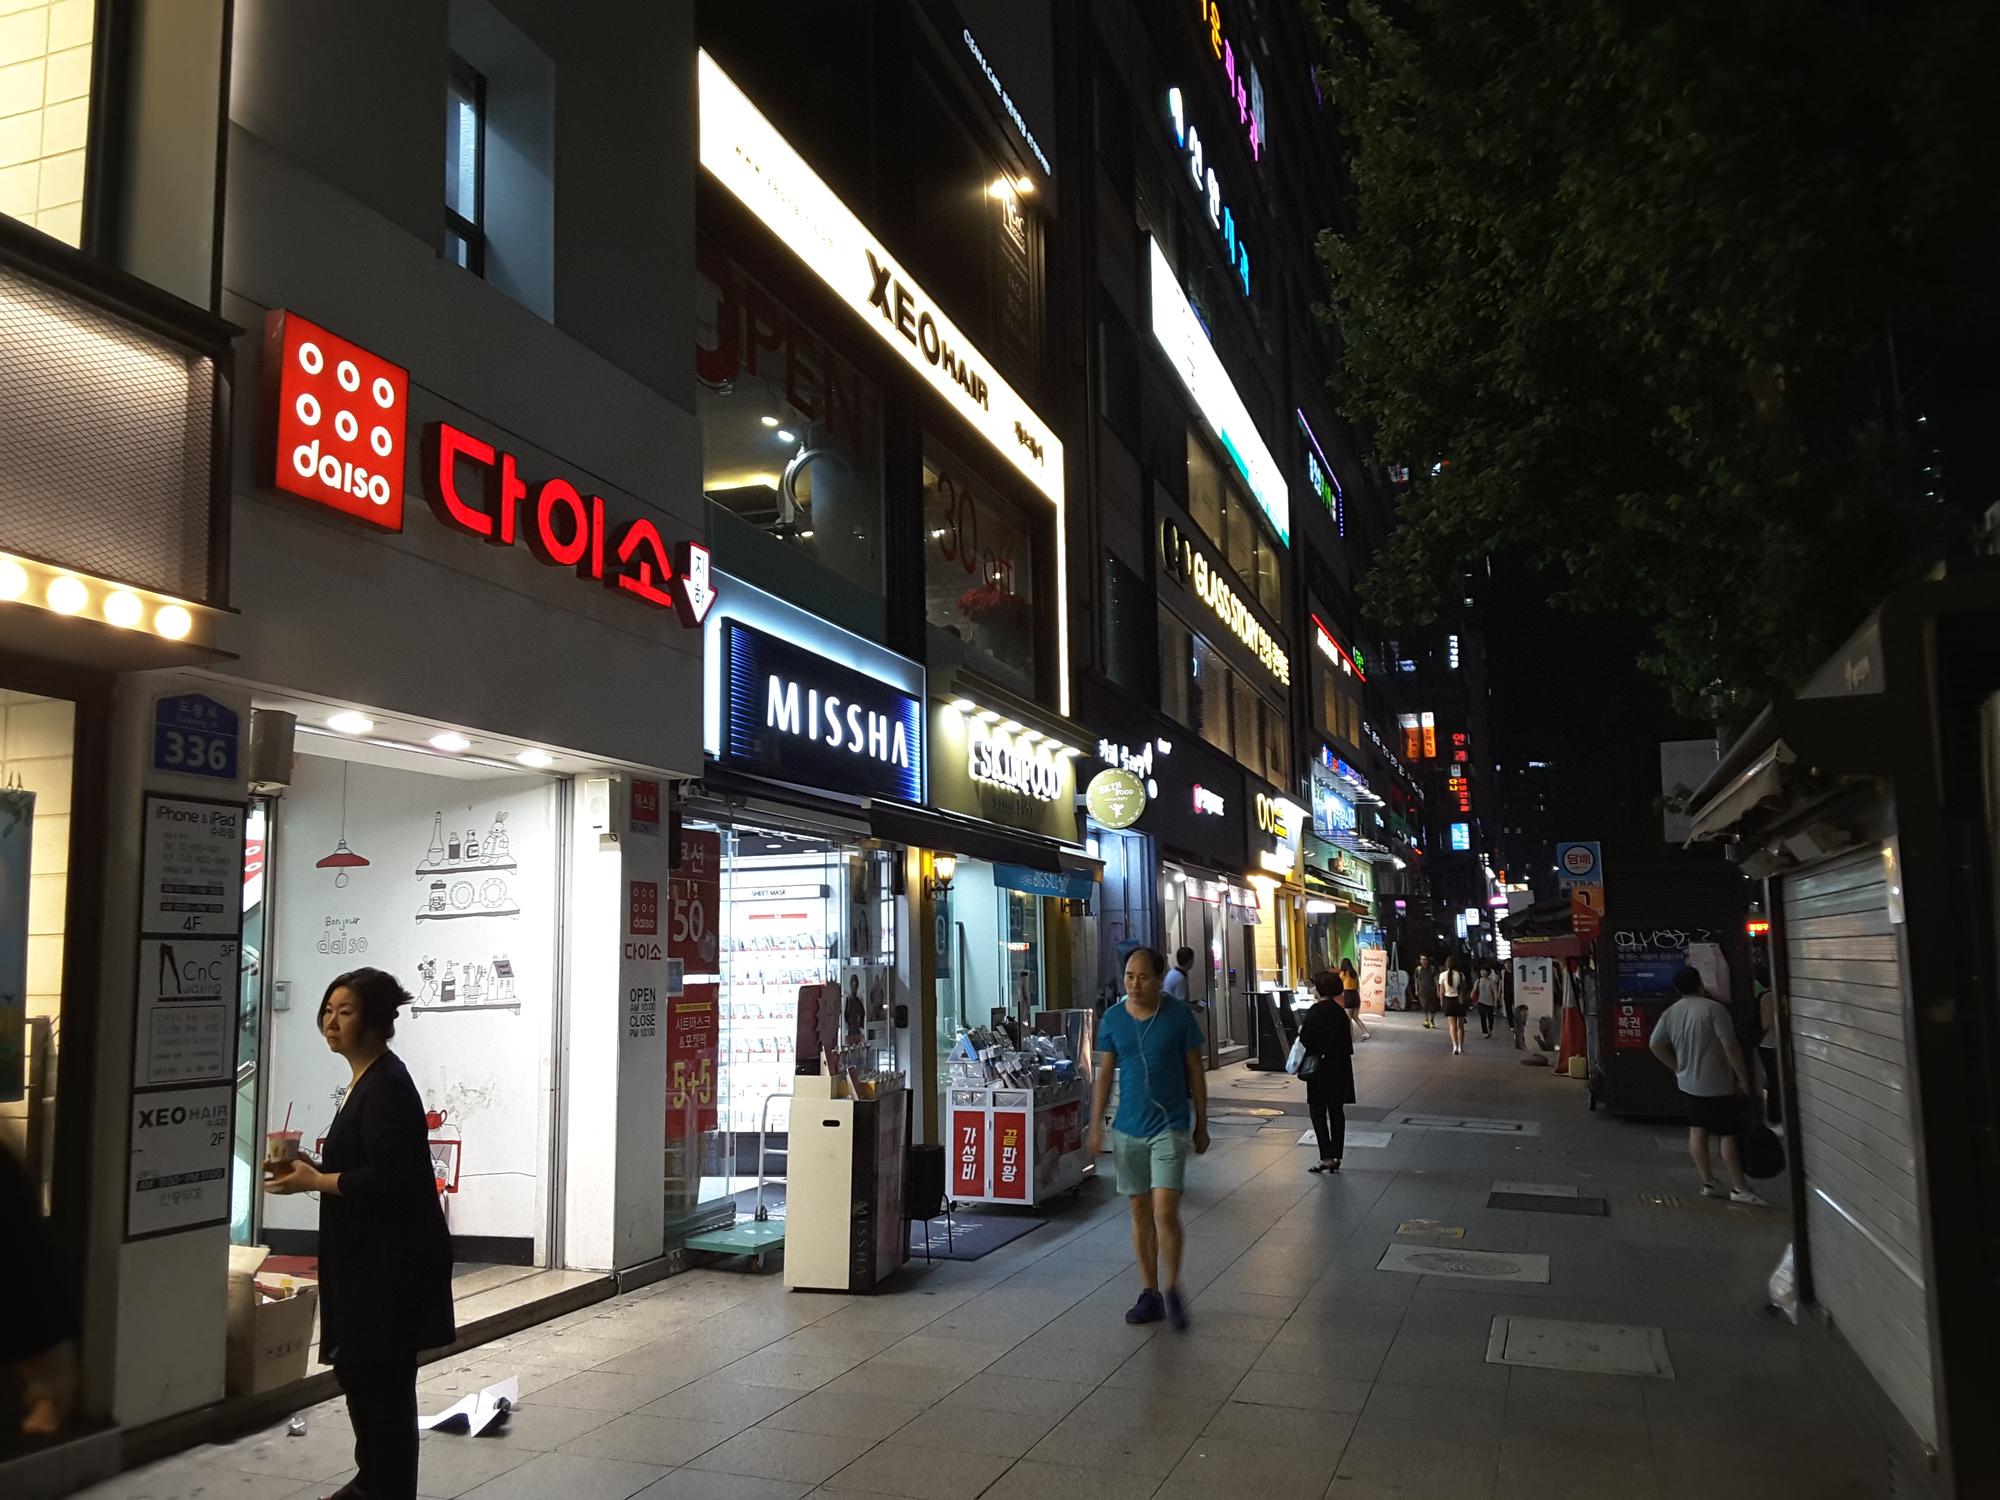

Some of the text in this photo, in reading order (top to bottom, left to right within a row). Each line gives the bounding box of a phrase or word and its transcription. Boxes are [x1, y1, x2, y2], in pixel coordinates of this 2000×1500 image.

[864, 247, 989, 413] XEO HAIR
[292, 439, 390, 506] daiso
[437, 421, 673, 609] 다이소
[1194, 551, 1231, 625] GLASS
[1230, 592, 1259, 655] STORY
[767, 674, 909, 769] MISSHA
[165, 731, 227, 770] 336
[974, 739, 1063, 801] SKINFOOD
[156, 806, 199, 823] iPhone
[209, 811, 236, 827] iPad
[1567, 854, 1591, 865] 담배
[182, 915, 203, 931] 4F
[325, 916, 361, 931] Bonjour
[633, 915, 655, 929] daiso
[672, 899, 705, 943] 50
[220, 944, 235, 958] 3F
[317, 931, 368, 955] daiso
[625, 943, 662, 961] 다이소
[183, 960, 223, 981] CnC
[1517, 964, 1547, 984] 1+1
[629, 987, 656, 1002] OPEN
[629, 1002, 640, 1012] AM
[629, 1013, 656, 1027] CLOSE
[675, 1015, 712, 1031] 시트마스크
[1617, 1016, 1641, 1029] 복권
[629, 1027, 639, 1037] PM
[673, 1058, 712, 1109] 5+5
[138, 1106, 187, 1129] XEO
[188, 1105, 228, 1121] HAIR
[210, 1131, 226, 1146] 2F
[961, 1127, 977, 1181] 가성비
[856, 1200, 869, 1274] MISSHA
